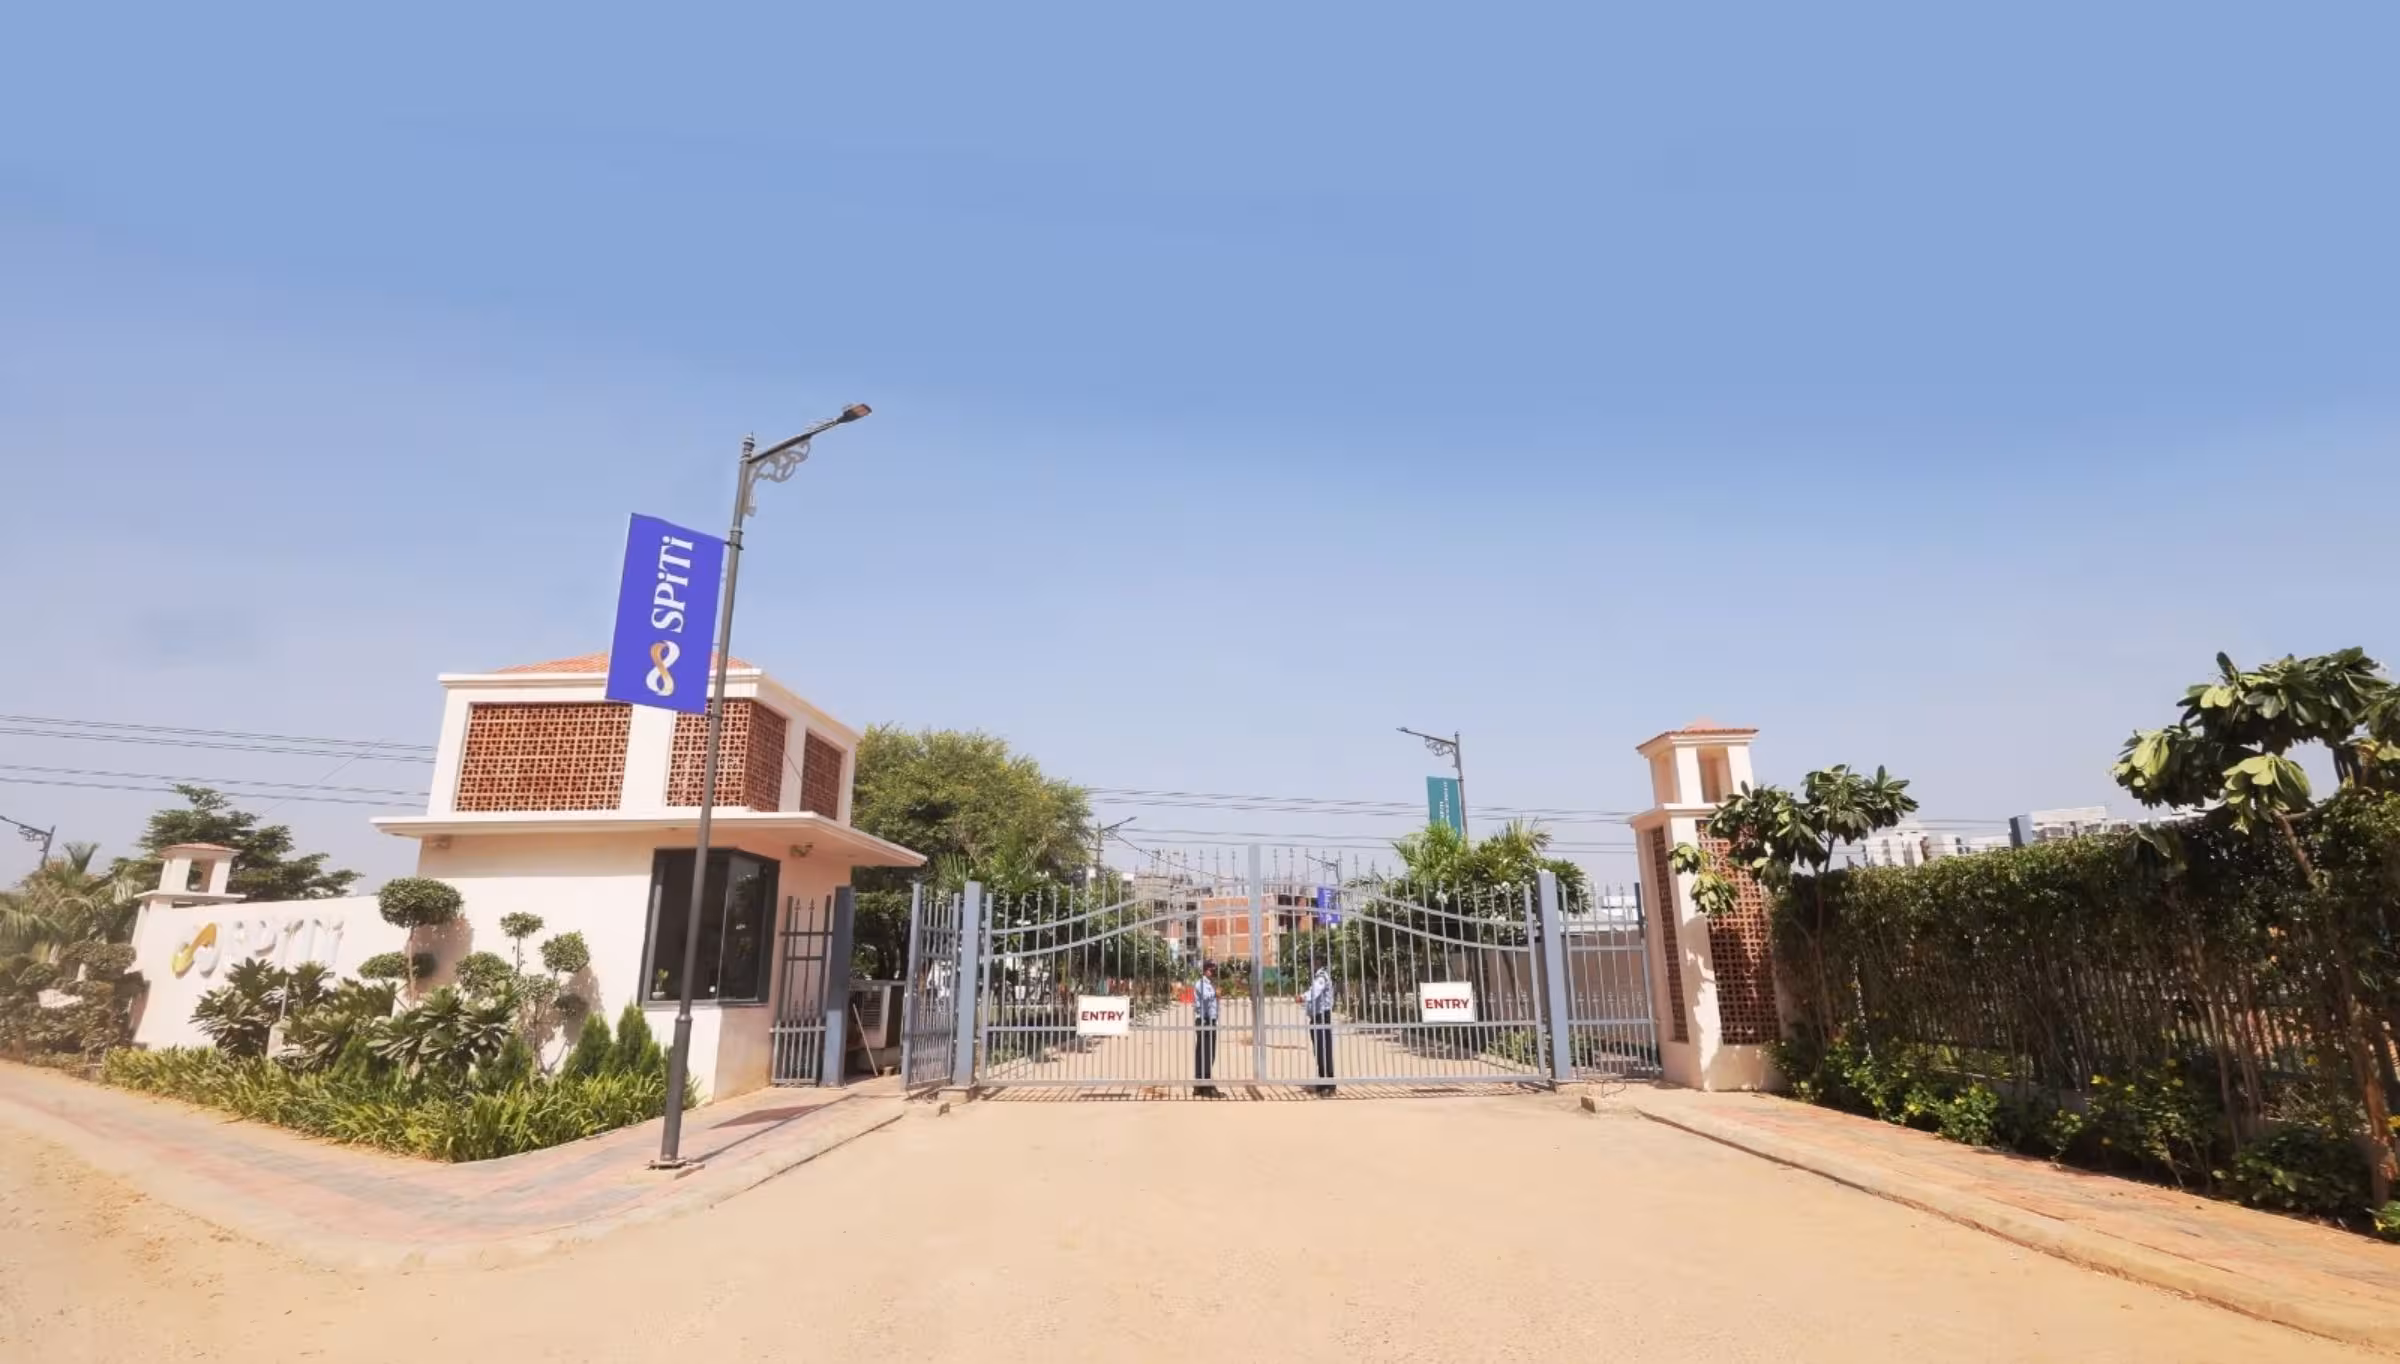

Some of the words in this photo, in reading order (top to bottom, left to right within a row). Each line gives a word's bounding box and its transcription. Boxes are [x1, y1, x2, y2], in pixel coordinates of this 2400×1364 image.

[651, 535, 694, 633] SPiTi
[1425, 998, 1469, 1009] ENTRY
[1081, 1010, 1124, 1021] ENTRY
